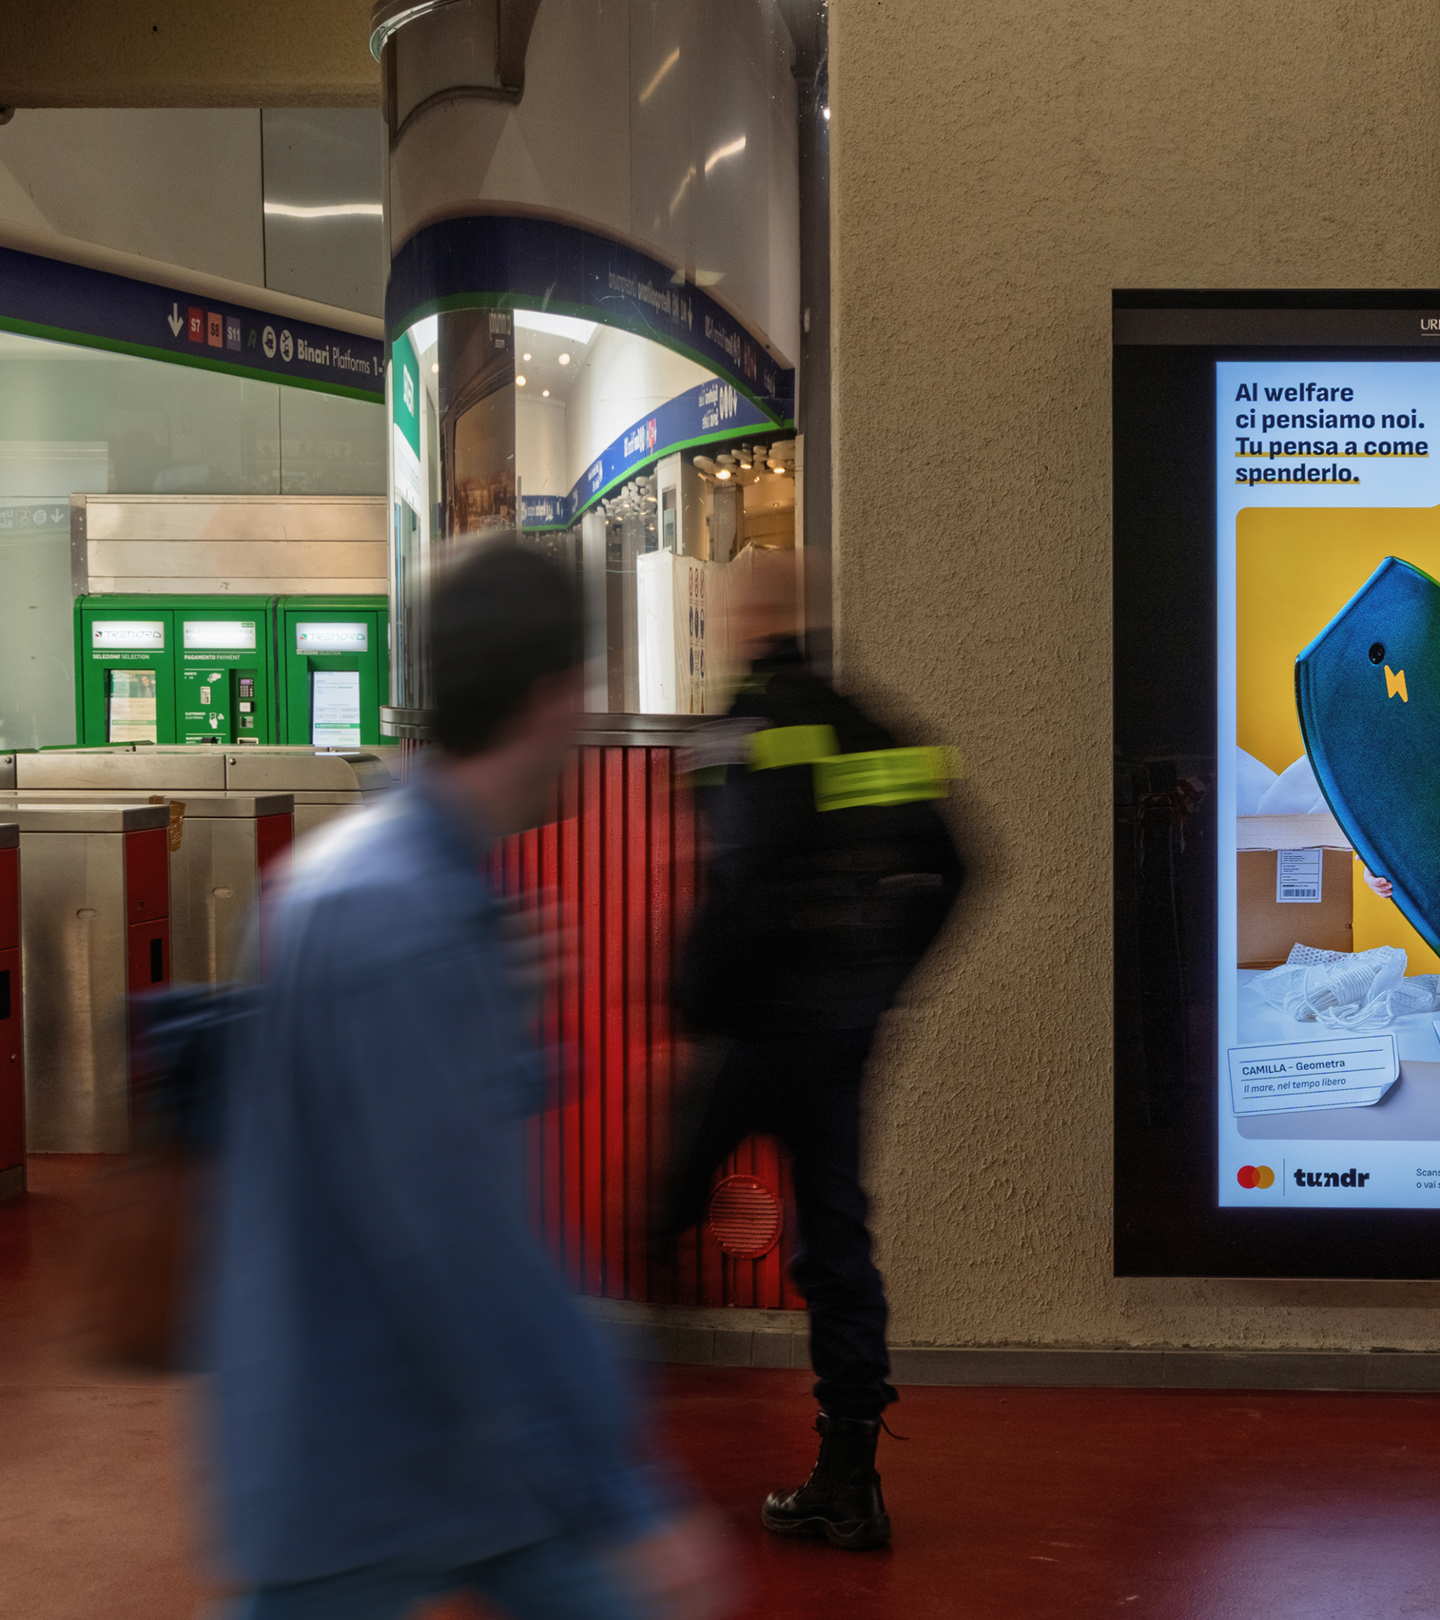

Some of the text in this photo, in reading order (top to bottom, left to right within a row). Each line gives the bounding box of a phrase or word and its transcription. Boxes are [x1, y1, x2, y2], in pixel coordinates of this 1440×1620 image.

[190, 318, 201, 333] S7
[210, 323, 220, 338] S8
[227, 327, 241, 342] S11
[297, 339, 330, 366] Binari
[332, 347, 370, 374] Platforms
[373, 356, 385, 378] 1-
[1235, 382, 1354, 402] Al welfare
[1235, 409, 1425, 434] ci pensiamo noi.
[1236, 437, 1428, 460] Tu pensa a come
[1235, 463, 1360, 487] spenderlo.
[105, 630, 162, 639] TRENORD
[308, 632, 366, 641] TRENORD
[1242, 1063, 1287, 1076] CAMILLA
[1295, 1059, 1346, 1071] Geometra
[1244, 1078, 1347, 1093] Il mare, nel tempo libero
[1293, 1168, 1370, 1188] tundr
[1423, 1180, 1437, 1189] vai
